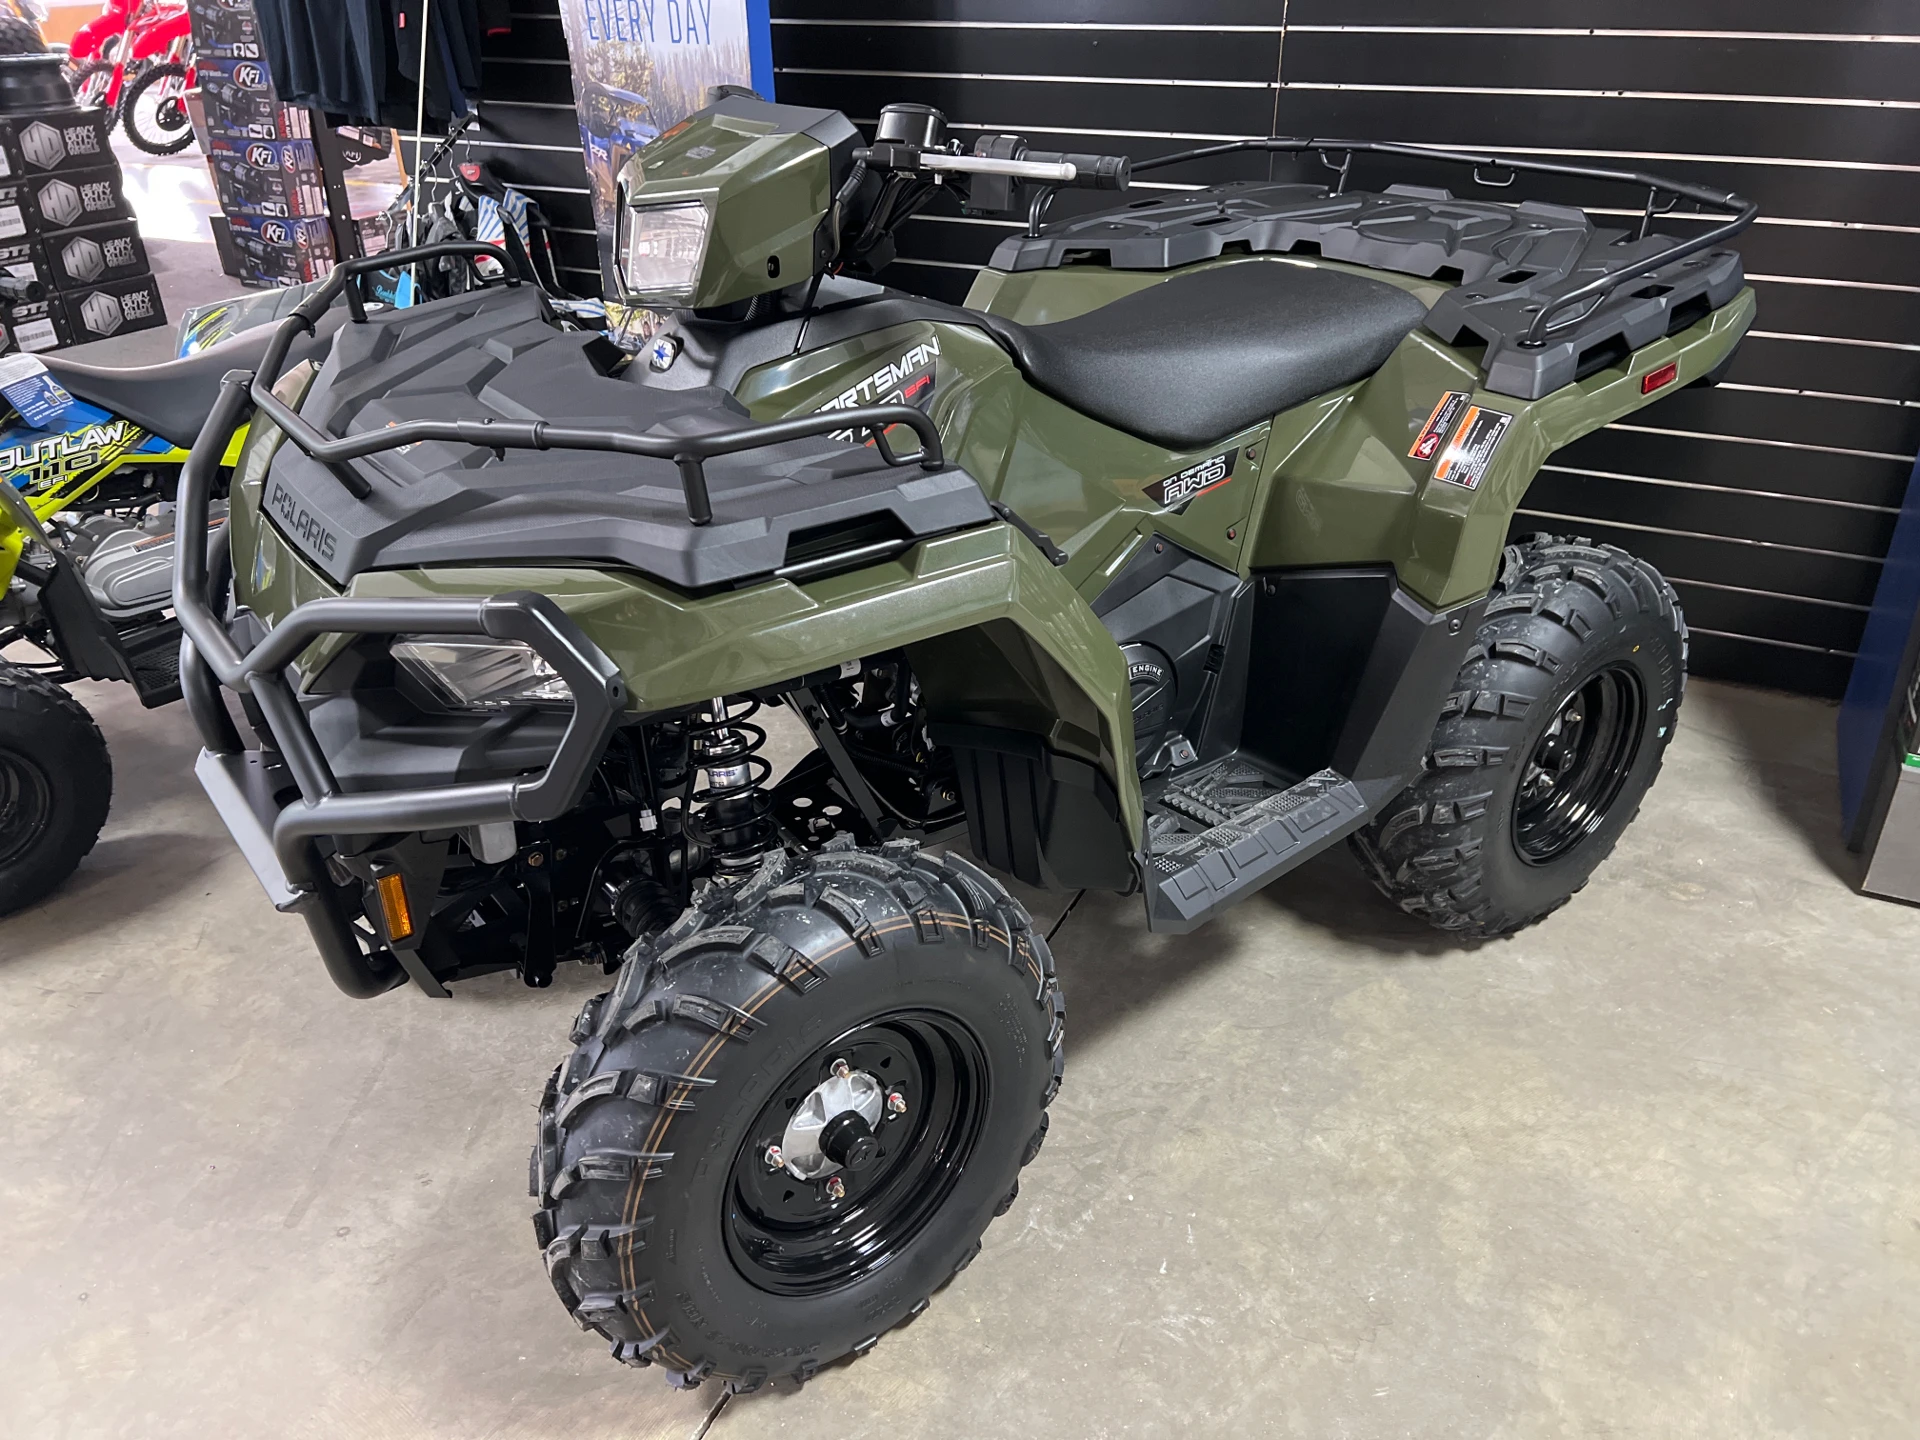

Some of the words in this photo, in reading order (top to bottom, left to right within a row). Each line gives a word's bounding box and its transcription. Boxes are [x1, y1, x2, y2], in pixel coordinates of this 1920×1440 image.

[585, 0, 655, 43] EVERY
[667, 0, 711, 45] DAY
[813, 335, 942, 413] RTSMAN
[904, 375, 931, 399] EFI
[0, 421, 125, 472] OUTLAW
[30, 450, 101, 483] 110
[40, 475, 68, 489] EFI
[1164, 463, 1226, 504] AWD
[272, 482, 338, 562] POLARIS
[1132, 664, 1162, 676] ENGINE
